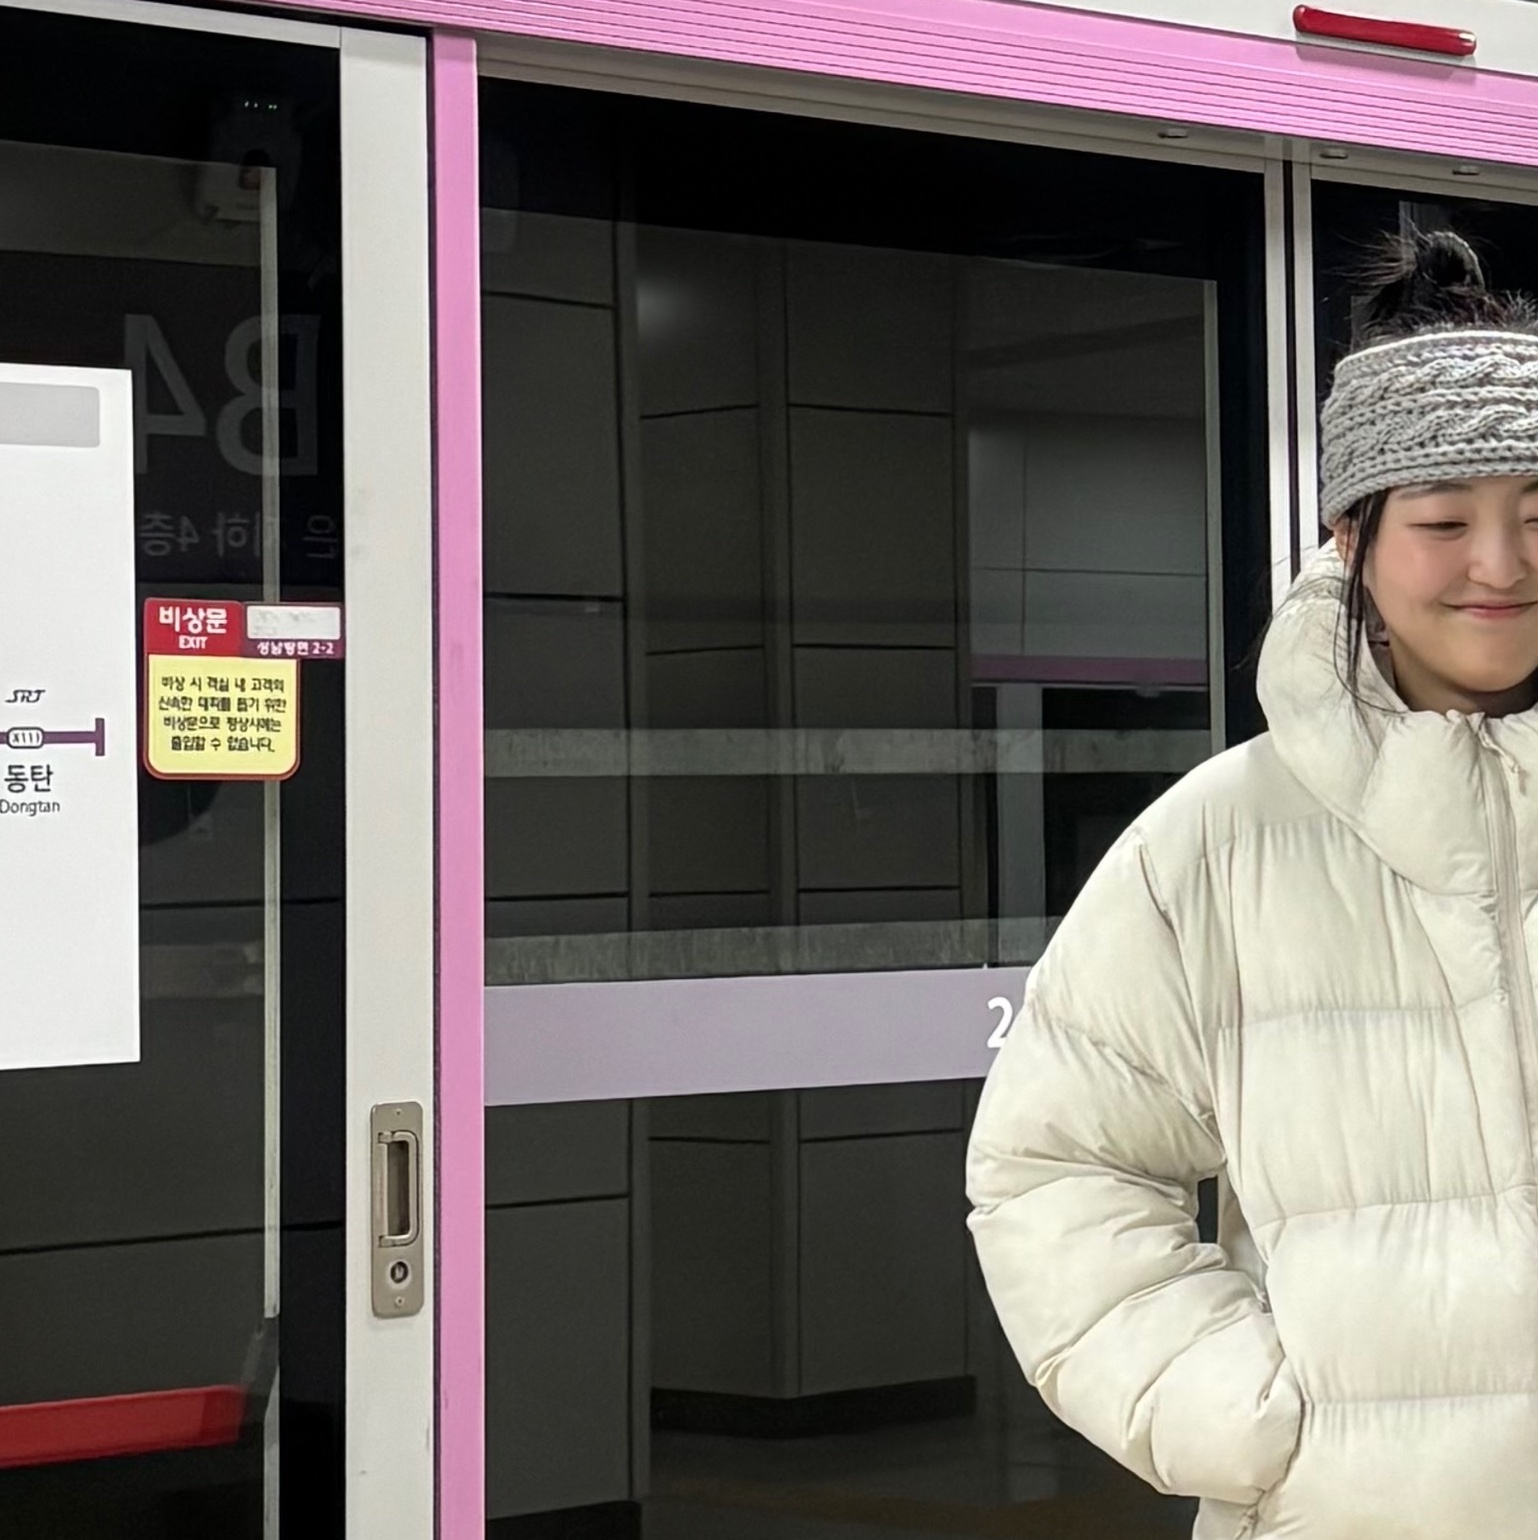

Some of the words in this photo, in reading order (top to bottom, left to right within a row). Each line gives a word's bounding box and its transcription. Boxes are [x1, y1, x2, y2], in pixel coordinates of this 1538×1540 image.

[159, 606, 227, 634] 비상문
[178, 635, 208, 649] EXIT
[312, 641, 334, 655] 2-2
[162, 676, 185, 691] 비상
[190, 676, 202, 691] 시
[4, 689, 46, 703] SRT
[164, 716, 221, 731] 비상문으로
[210, 737, 221, 751] 수
[4, 763, 54, 793] 동탄
[0, 798, 61, 817] Dongtan
